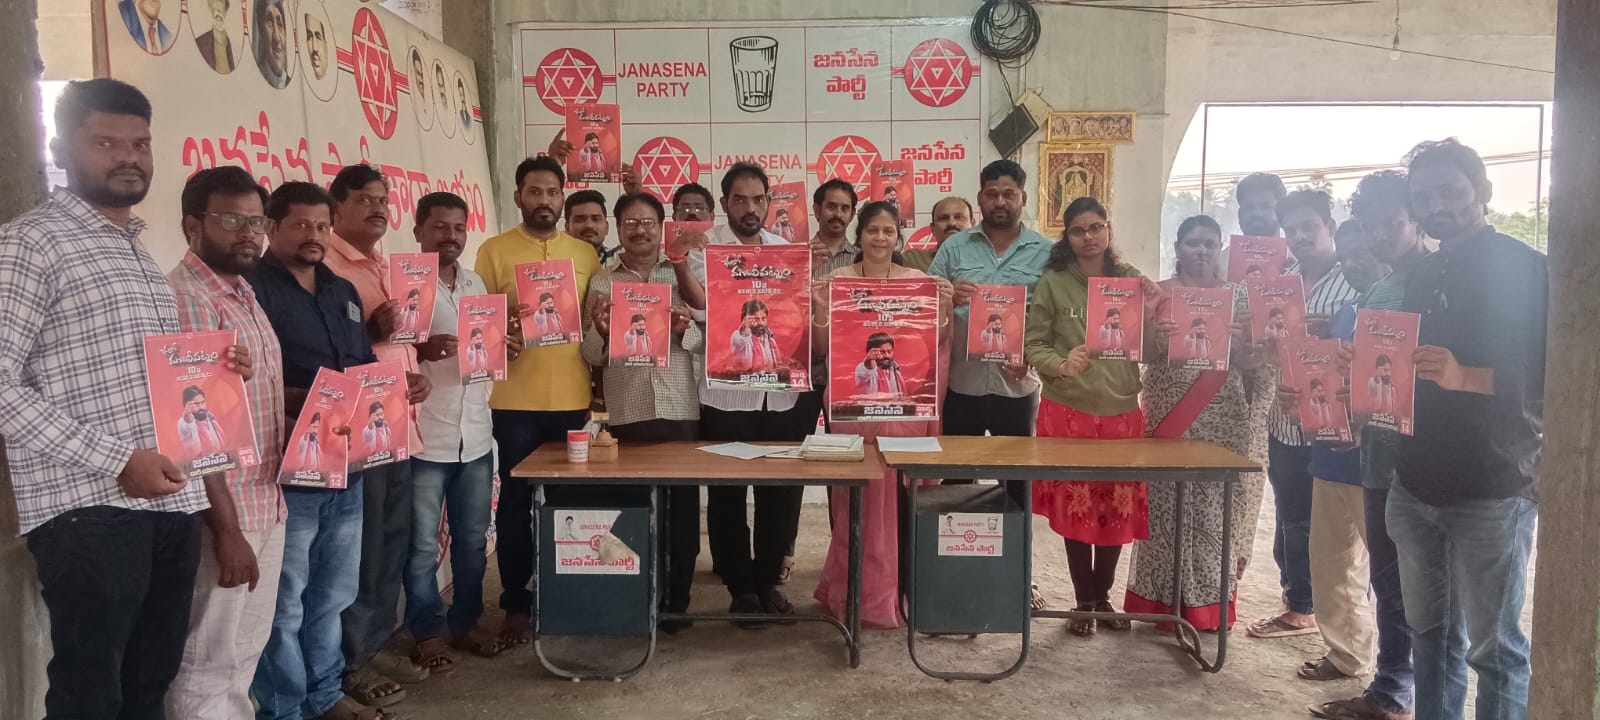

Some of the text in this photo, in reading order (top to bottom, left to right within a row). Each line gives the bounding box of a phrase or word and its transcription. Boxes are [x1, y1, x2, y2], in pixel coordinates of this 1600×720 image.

[813, 47, 879, 68] జనసేన
[618, 62, 707, 78] JANASENA
[637, 82, 690, 97] PARTY
[826, 74, 867, 100] పార్టీ
[901, 140, 965, 160] జనసేన
[914, 167, 953, 192] పార్టీ
